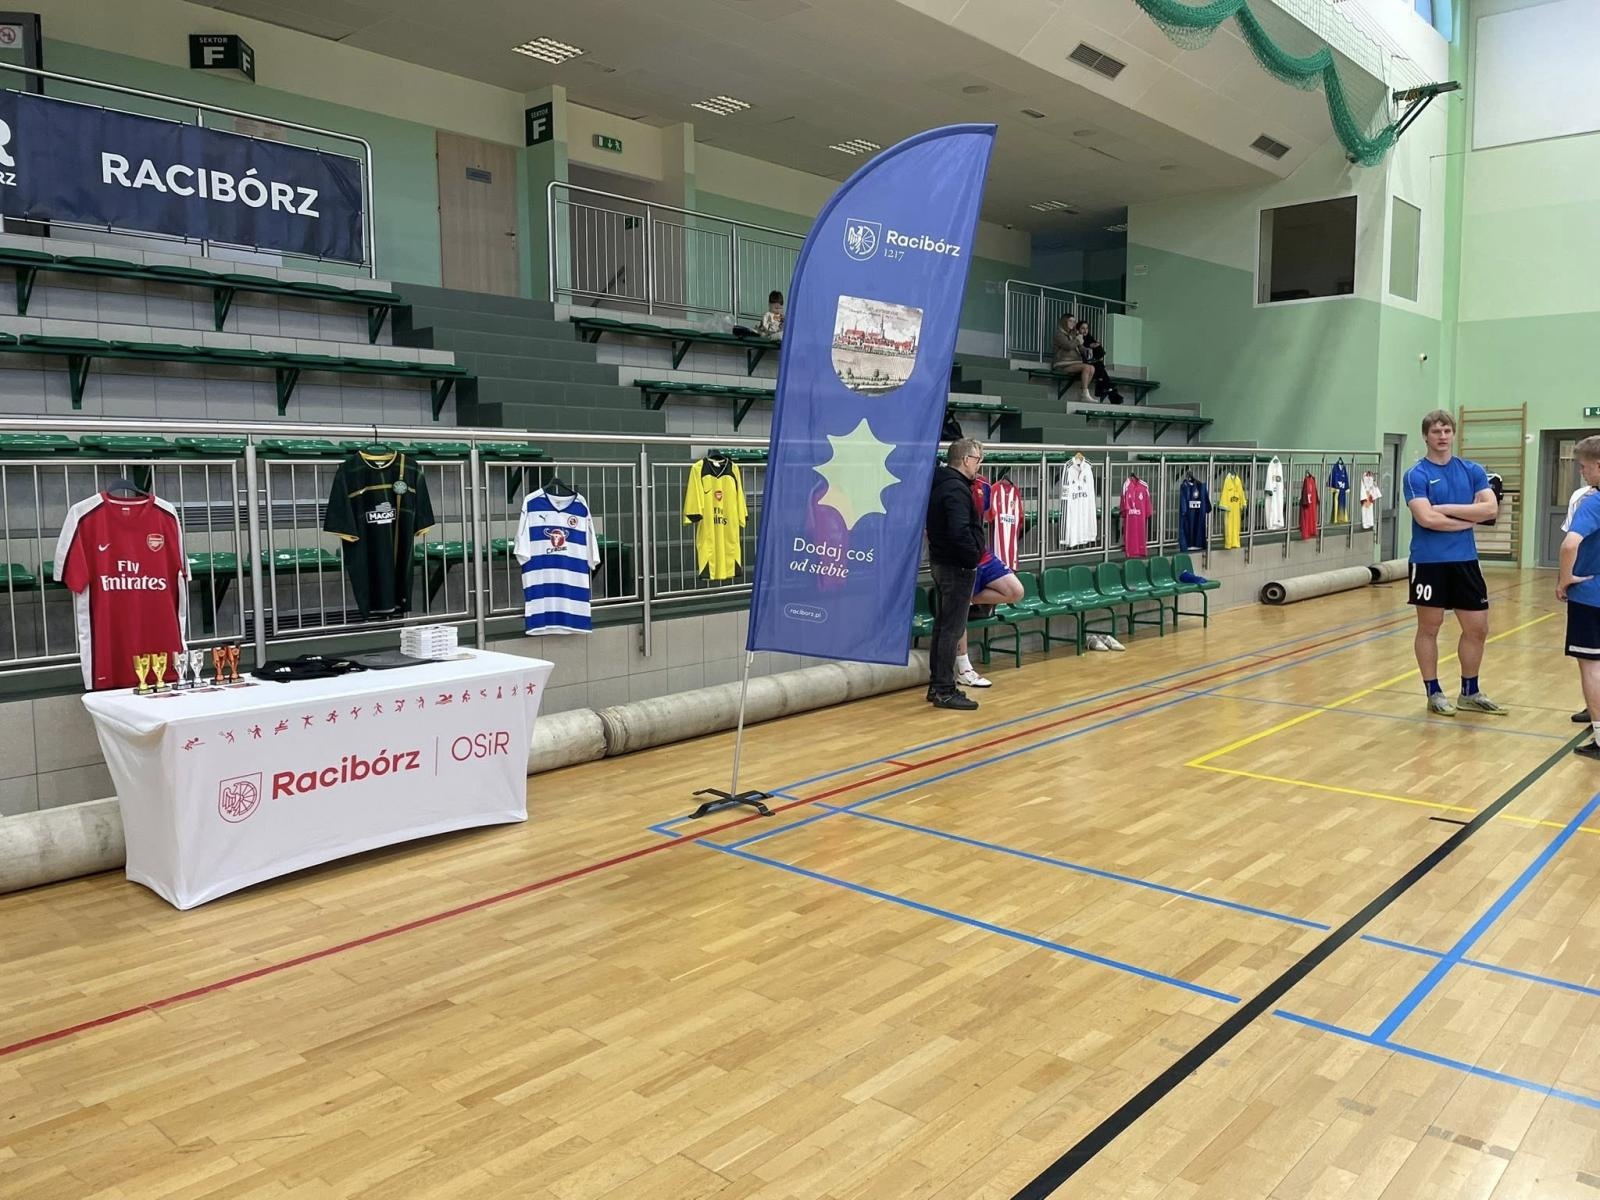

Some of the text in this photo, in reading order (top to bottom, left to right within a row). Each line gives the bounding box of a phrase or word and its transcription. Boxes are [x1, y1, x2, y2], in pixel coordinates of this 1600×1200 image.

[203, 46, 225, 66] F
[242, 51, 251, 73] F
[532, 117, 547, 140] F
[101, 151, 320, 218] RACIBÓRZ
[885, 229, 961, 257] Racibórz
[882, 248, 905, 262] 1217
[793, 537, 875, 562] Dodaj coś
[117, 560, 140, 574] Fly
[789, 558, 850, 578] od siebie
[1415, 583, 1433, 601] 90
[271, 731, 510, 800] Racibórz OSiR
